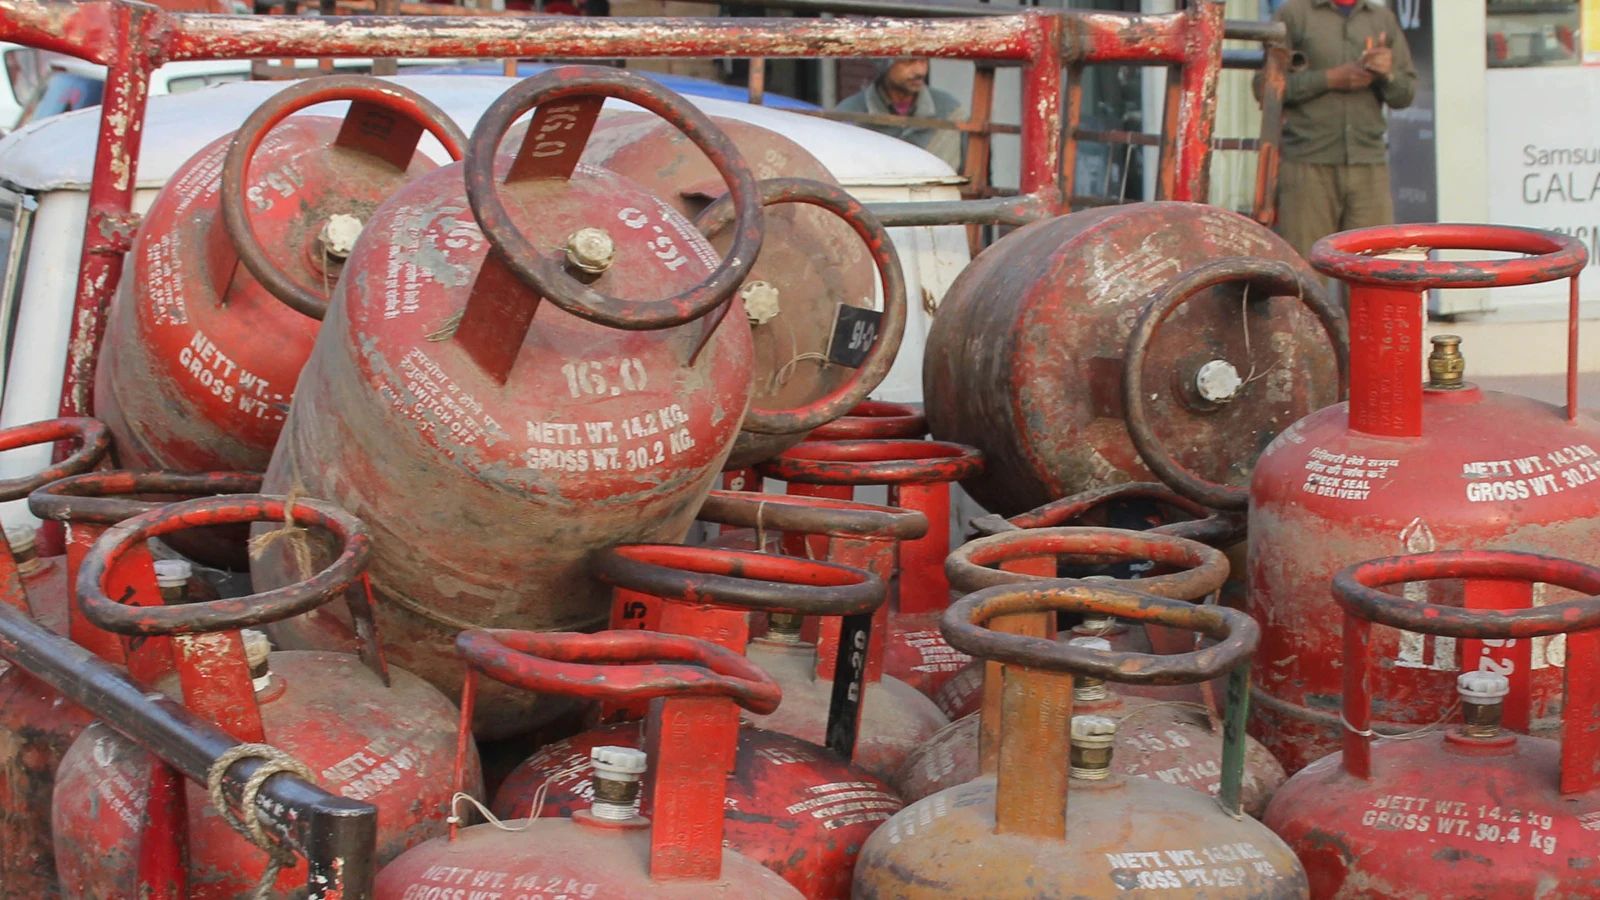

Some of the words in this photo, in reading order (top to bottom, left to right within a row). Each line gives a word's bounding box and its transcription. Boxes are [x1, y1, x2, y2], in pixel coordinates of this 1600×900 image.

[191, 329, 237, 378] NETT
[179, 347, 236, 403] GROSS
[561, 358, 649, 398] 16.0
[408, 381, 453, 423] SWITCH
[451, 421, 477, 443] OFF
[621, 413, 658, 440] 14.2
[659, 403, 689, 430] KG.
[524, 447, 589, 472] GROSS
[626, 441, 665, 471] 30.2
[669, 429, 696, 455] KG.
[1462, 460, 1514, 477] NETT
[1307, 473, 1341, 487] CHECK
[1342, 479, 1371, 490] SEAL
[1317, 485, 1371, 500] DELIVERY
[1466, 480, 1530, 502] GROSS
[1562, 463, 1597, 488] 30.2
[1373, 795, 1430, 811] NETT
[1434, 800, 1469, 817] WT.
[1527, 811, 1554, 830] kg
[1361, 810, 1431, 832] GROSS
[1437, 817, 1472, 837] WT.
[1530, 830, 1557, 855] kg
[402, 883, 465, 900] GROSS
[420, 863, 473, 885] NETT
[471, 870, 506, 889] WT.
[511, 875, 562, 893] 14.2
[1110, 868, 1182, 890] OSS
